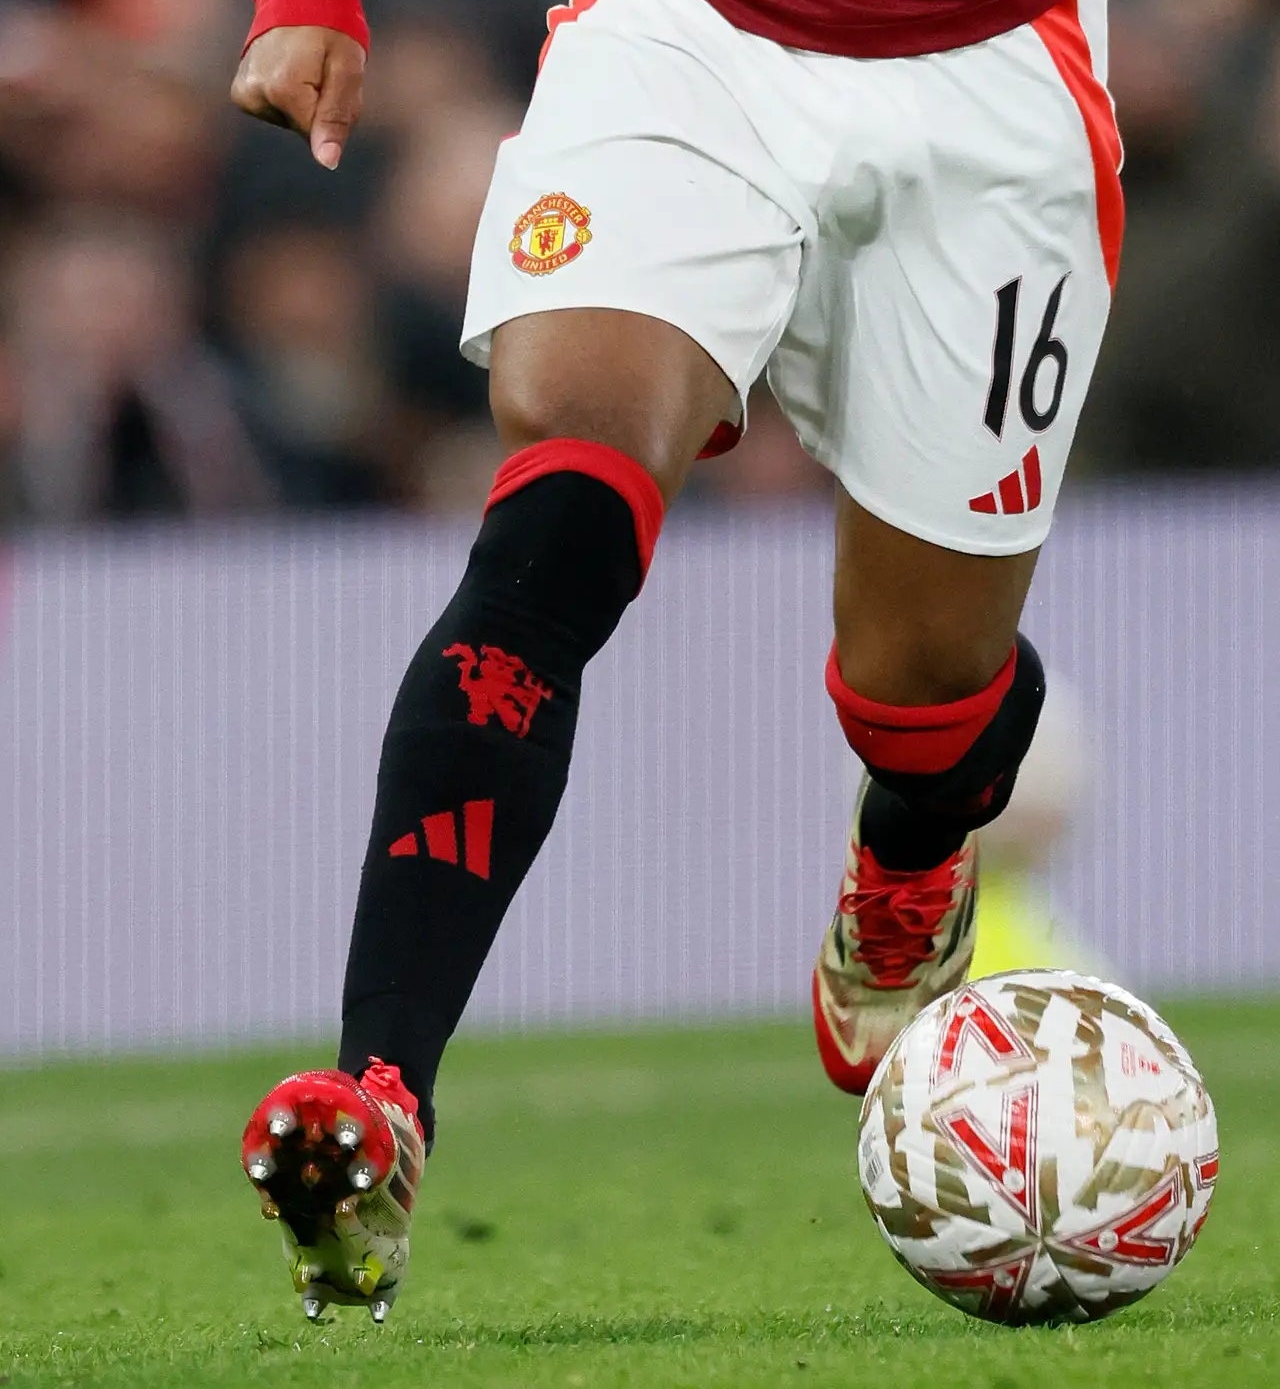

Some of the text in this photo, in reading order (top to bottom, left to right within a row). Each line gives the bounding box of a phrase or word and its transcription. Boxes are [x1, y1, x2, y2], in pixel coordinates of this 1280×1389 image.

[519, 198, 583, 231] MANCHESTER
[521, 254, 568, 270] UNITED
[981, 270, 1072, 444] 16
